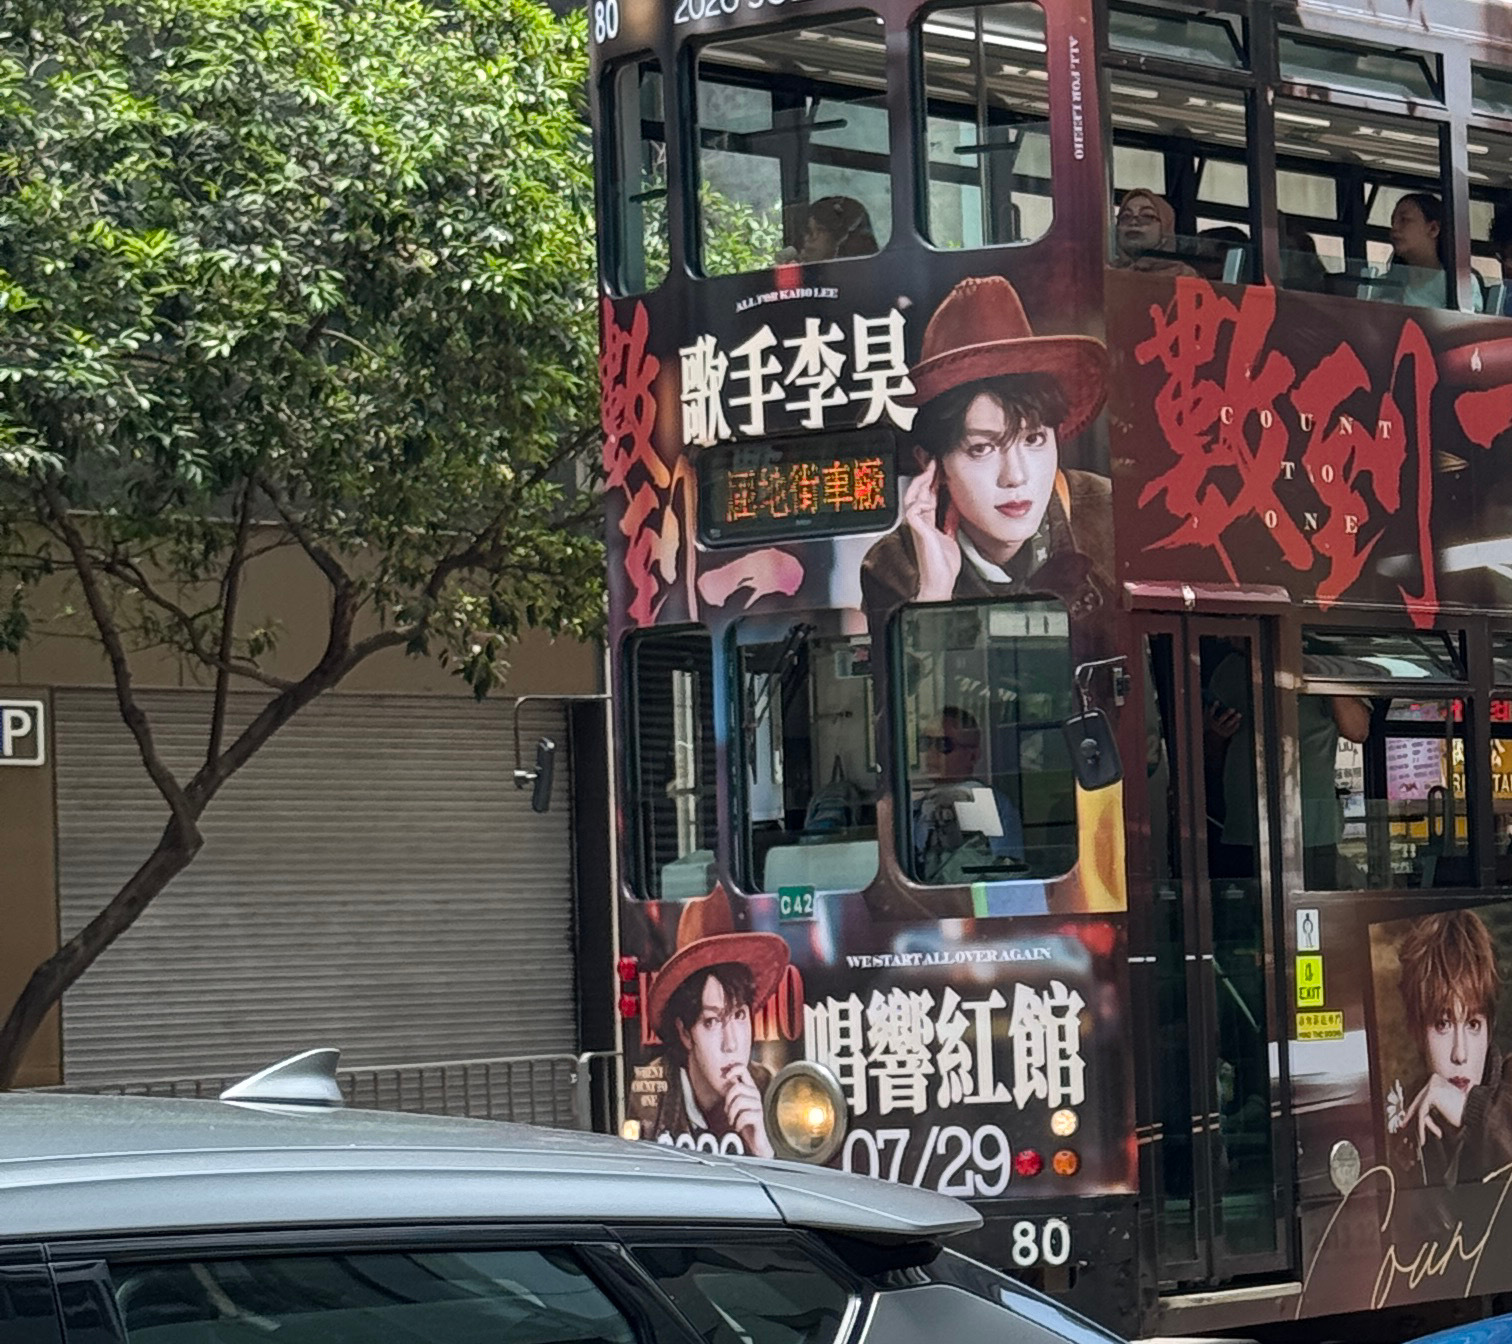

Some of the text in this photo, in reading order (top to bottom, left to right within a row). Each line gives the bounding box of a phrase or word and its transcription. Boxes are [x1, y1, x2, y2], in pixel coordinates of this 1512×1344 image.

[680, 308, 920, 448] 歌手李昊
[1220, 404, 1394, 441] COUNT
[1281, 461, 1335, 484] TO
[1264, 509, 1359, 536] ONE
[2, 709, 32, 757] P
[1298, 986, 1321, 1000] EXIT
[803, 980, 1086, 1116] 唱響紅館
[842, 1125, 1012, 1197] 07/29
[1012, 1219, 1071, 1265] 80
